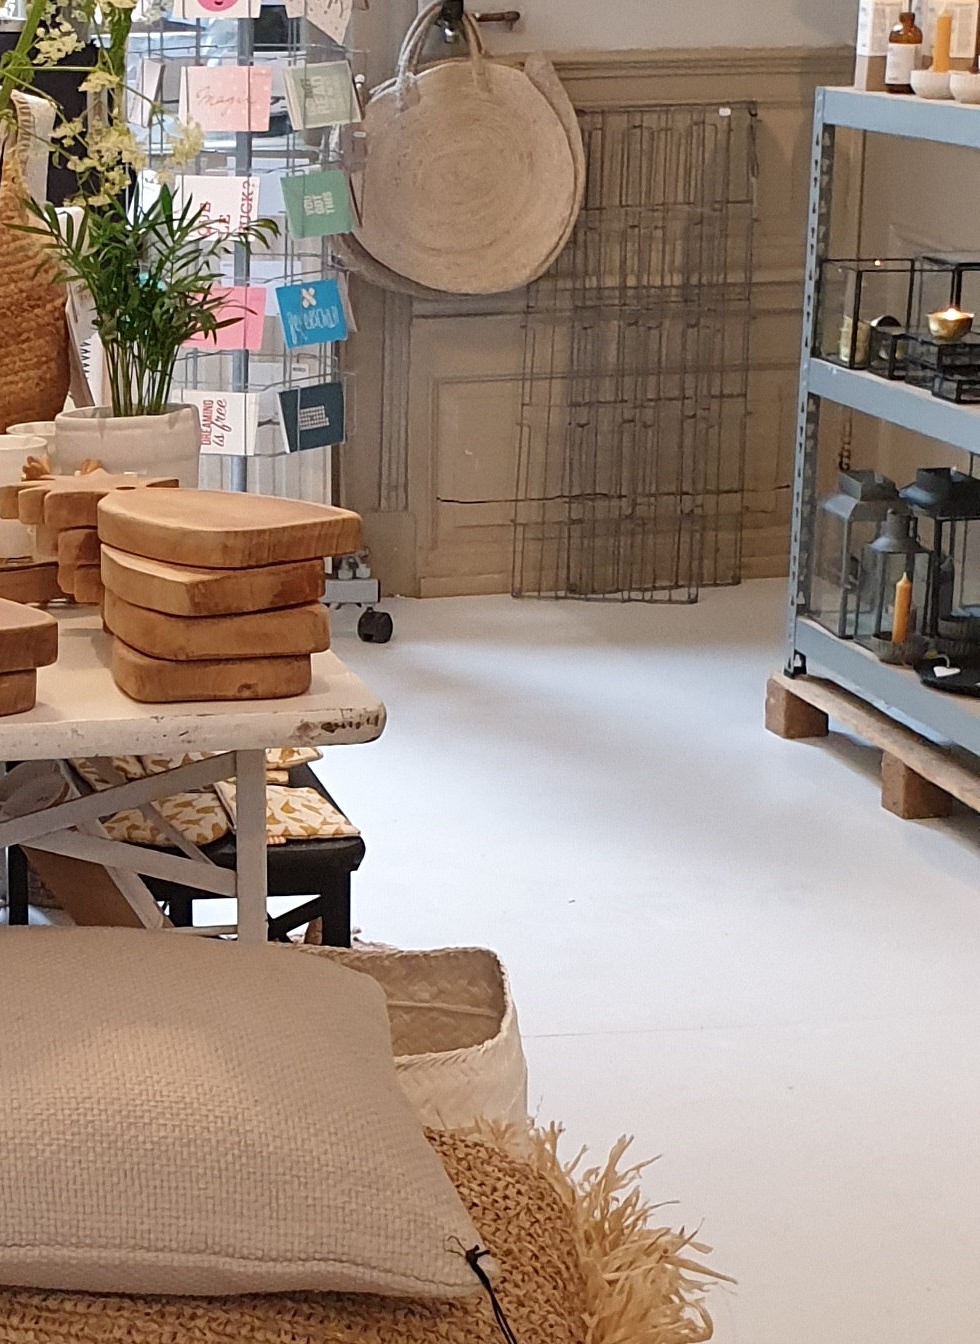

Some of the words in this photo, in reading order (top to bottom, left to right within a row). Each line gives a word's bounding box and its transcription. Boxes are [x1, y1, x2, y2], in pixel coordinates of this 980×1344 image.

[304, 195, 315, 216] YOU
[314, 194, 325, 215] GOT
[323, 191, 336, 215] THIS
[200, 399, 213, 446] DREAMING
[211, 399, 232, 433] free
[212, 433, 225, 447] is
